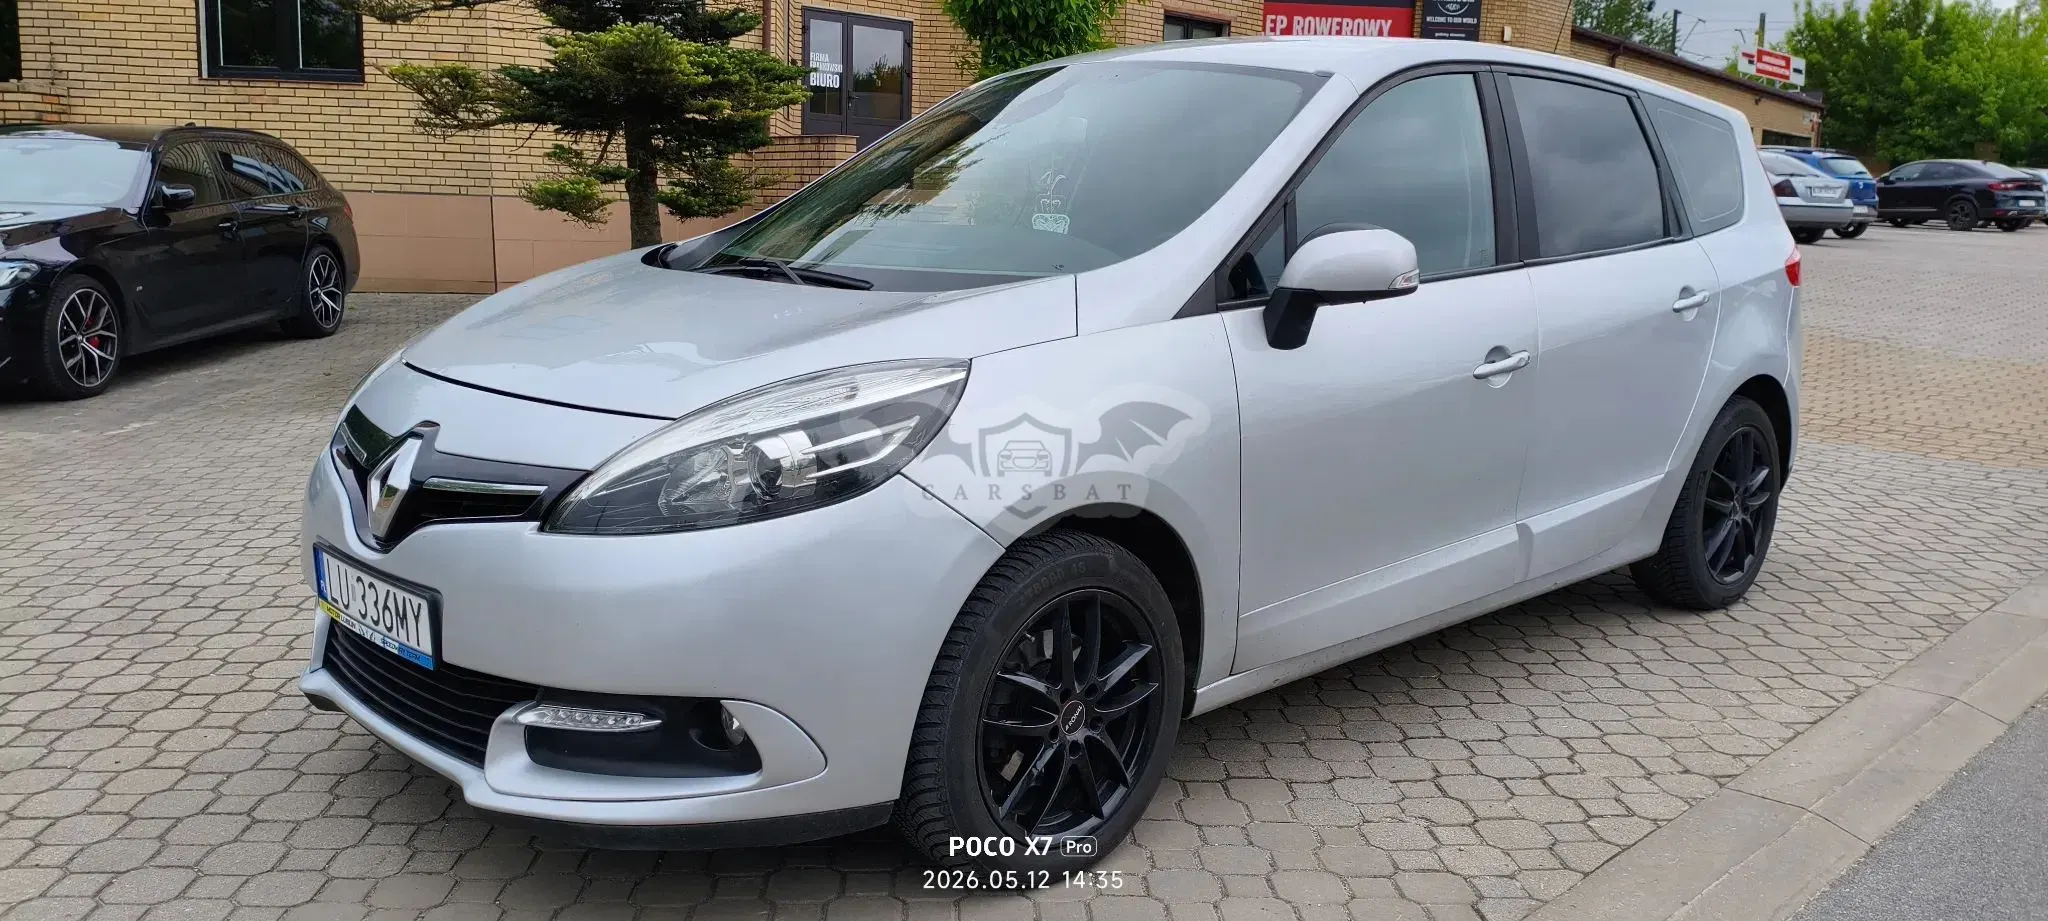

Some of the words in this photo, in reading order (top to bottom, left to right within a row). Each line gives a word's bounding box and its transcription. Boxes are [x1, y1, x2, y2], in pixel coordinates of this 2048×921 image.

[1292, 15, 1393, 37] ROWEROWY
[810, 52, 830, 62] FIRMA
[810, 72, 840, 88] BIURO
[355, 575, 422, 647] 336MY
